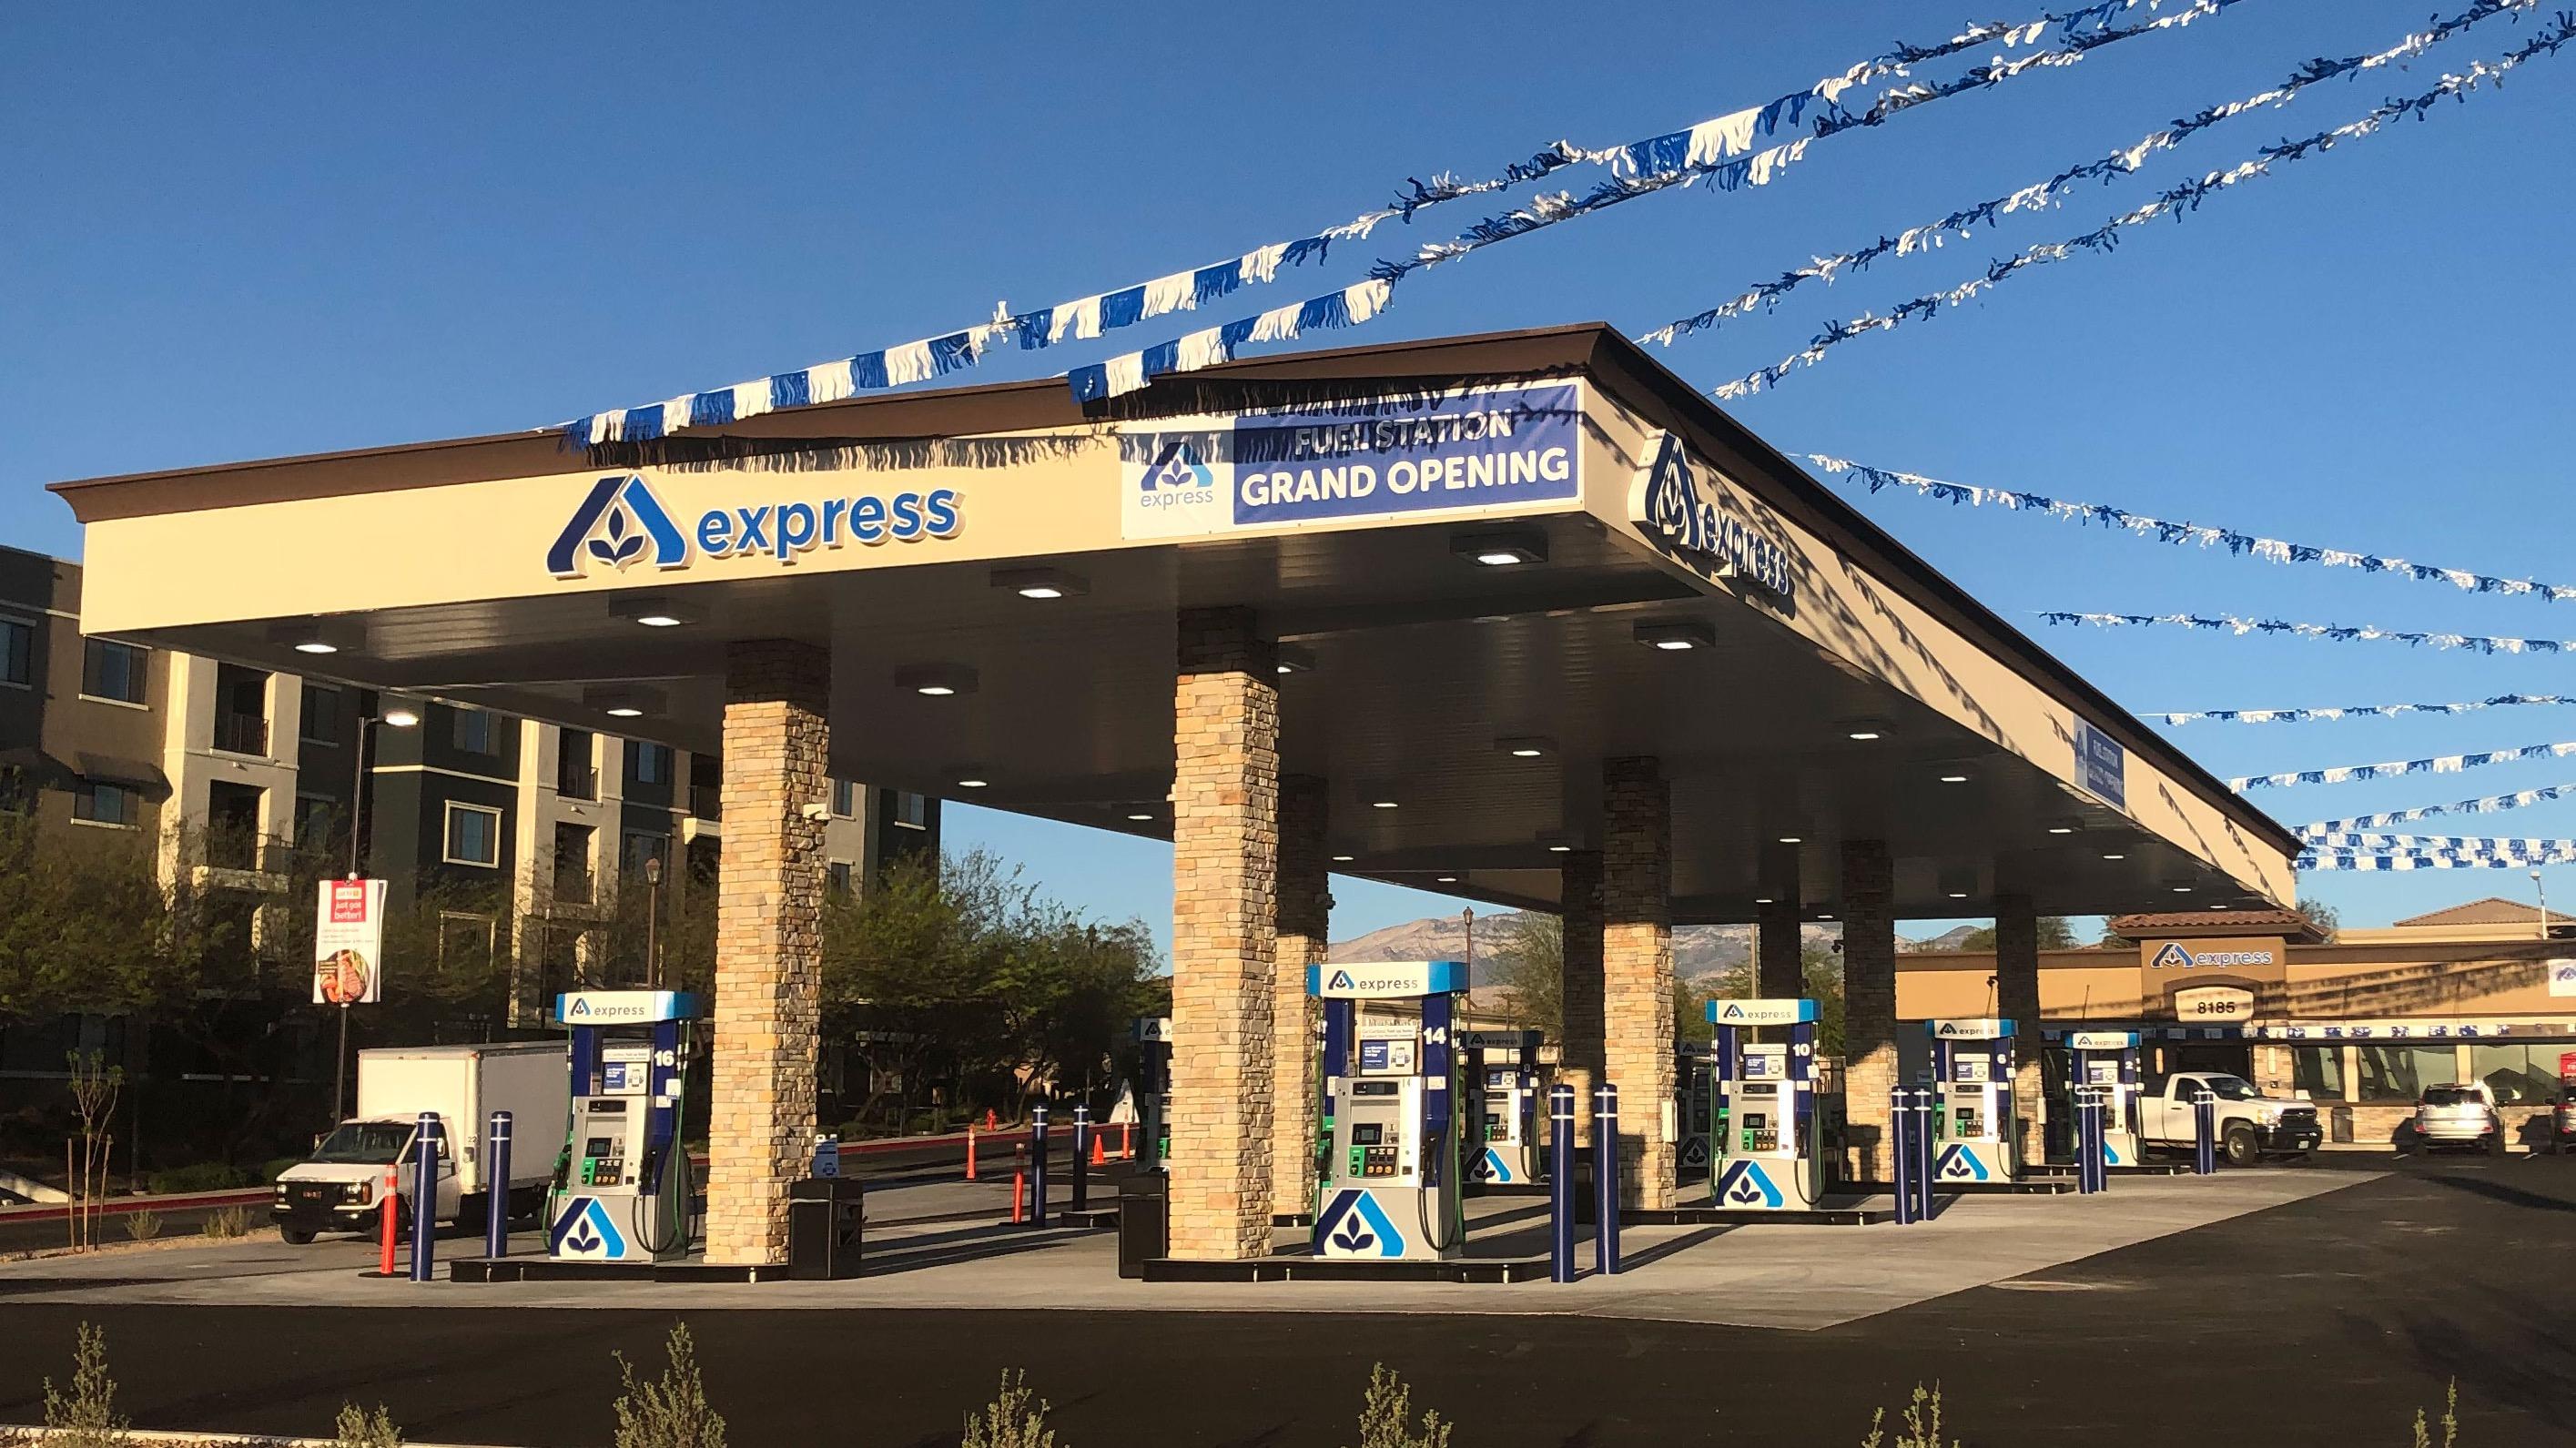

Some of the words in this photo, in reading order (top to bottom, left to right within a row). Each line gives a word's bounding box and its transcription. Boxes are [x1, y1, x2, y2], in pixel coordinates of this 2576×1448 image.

[1295, 423, 1369, 455] FUEL
[1375, 410, 1512, 448] STATION
[1241, 464, 1377, 507] GRAND
[1387, 447, 1569, 494] OPENING
[1141, 491, 1213, 511] express
[696, 488, 959, 563] express
[1702, 502, 1789, 595] express
[2196, 952, 2273, 967] express
[1359, 979, 1418, 991] express
[593, 1007, 645, 1018] express
[1748, 1011, 1791, 1019] express
[2197, 1001, 2236, 1014] 8185
[1423, 1026, 1446, 1045] 14
[1792, 1043, 1810, 1057] 10
[654, 1049, 674, 1067] 16
[1996, 1053, 2007, 1065] 6
[2125, 1060, 2135, 1070] 2
